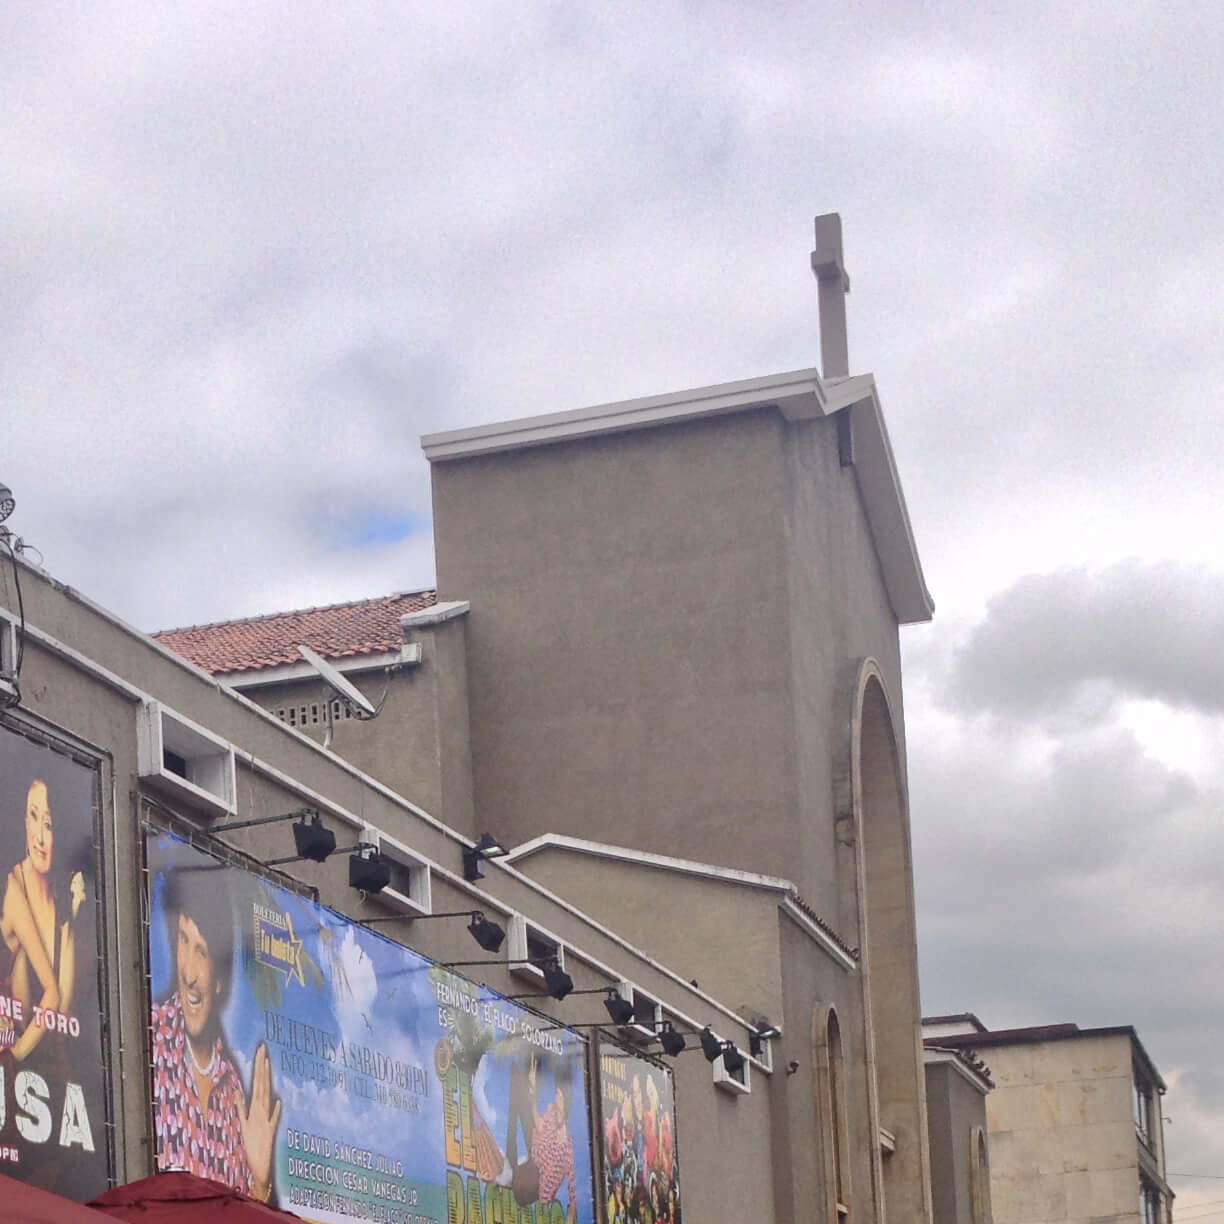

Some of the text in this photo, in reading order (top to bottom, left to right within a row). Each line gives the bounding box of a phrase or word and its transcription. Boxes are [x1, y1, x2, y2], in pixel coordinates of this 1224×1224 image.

[437, 983, 478, 1016] FERNANDO
[32, 1006, 80, 1037] TORO
[286, 1018, 336, 1063] JUEVES
[338, 1041, 348, 1068] A
[443, 1063, 477, 1174] EL
[287, 1128, 300, 1150] DE
[303, 1133, 331, 1158] DAVID
[288, 1158, 339, 1185] DIRECCION
[372, 1180, 406, 1204] VANEGAS
